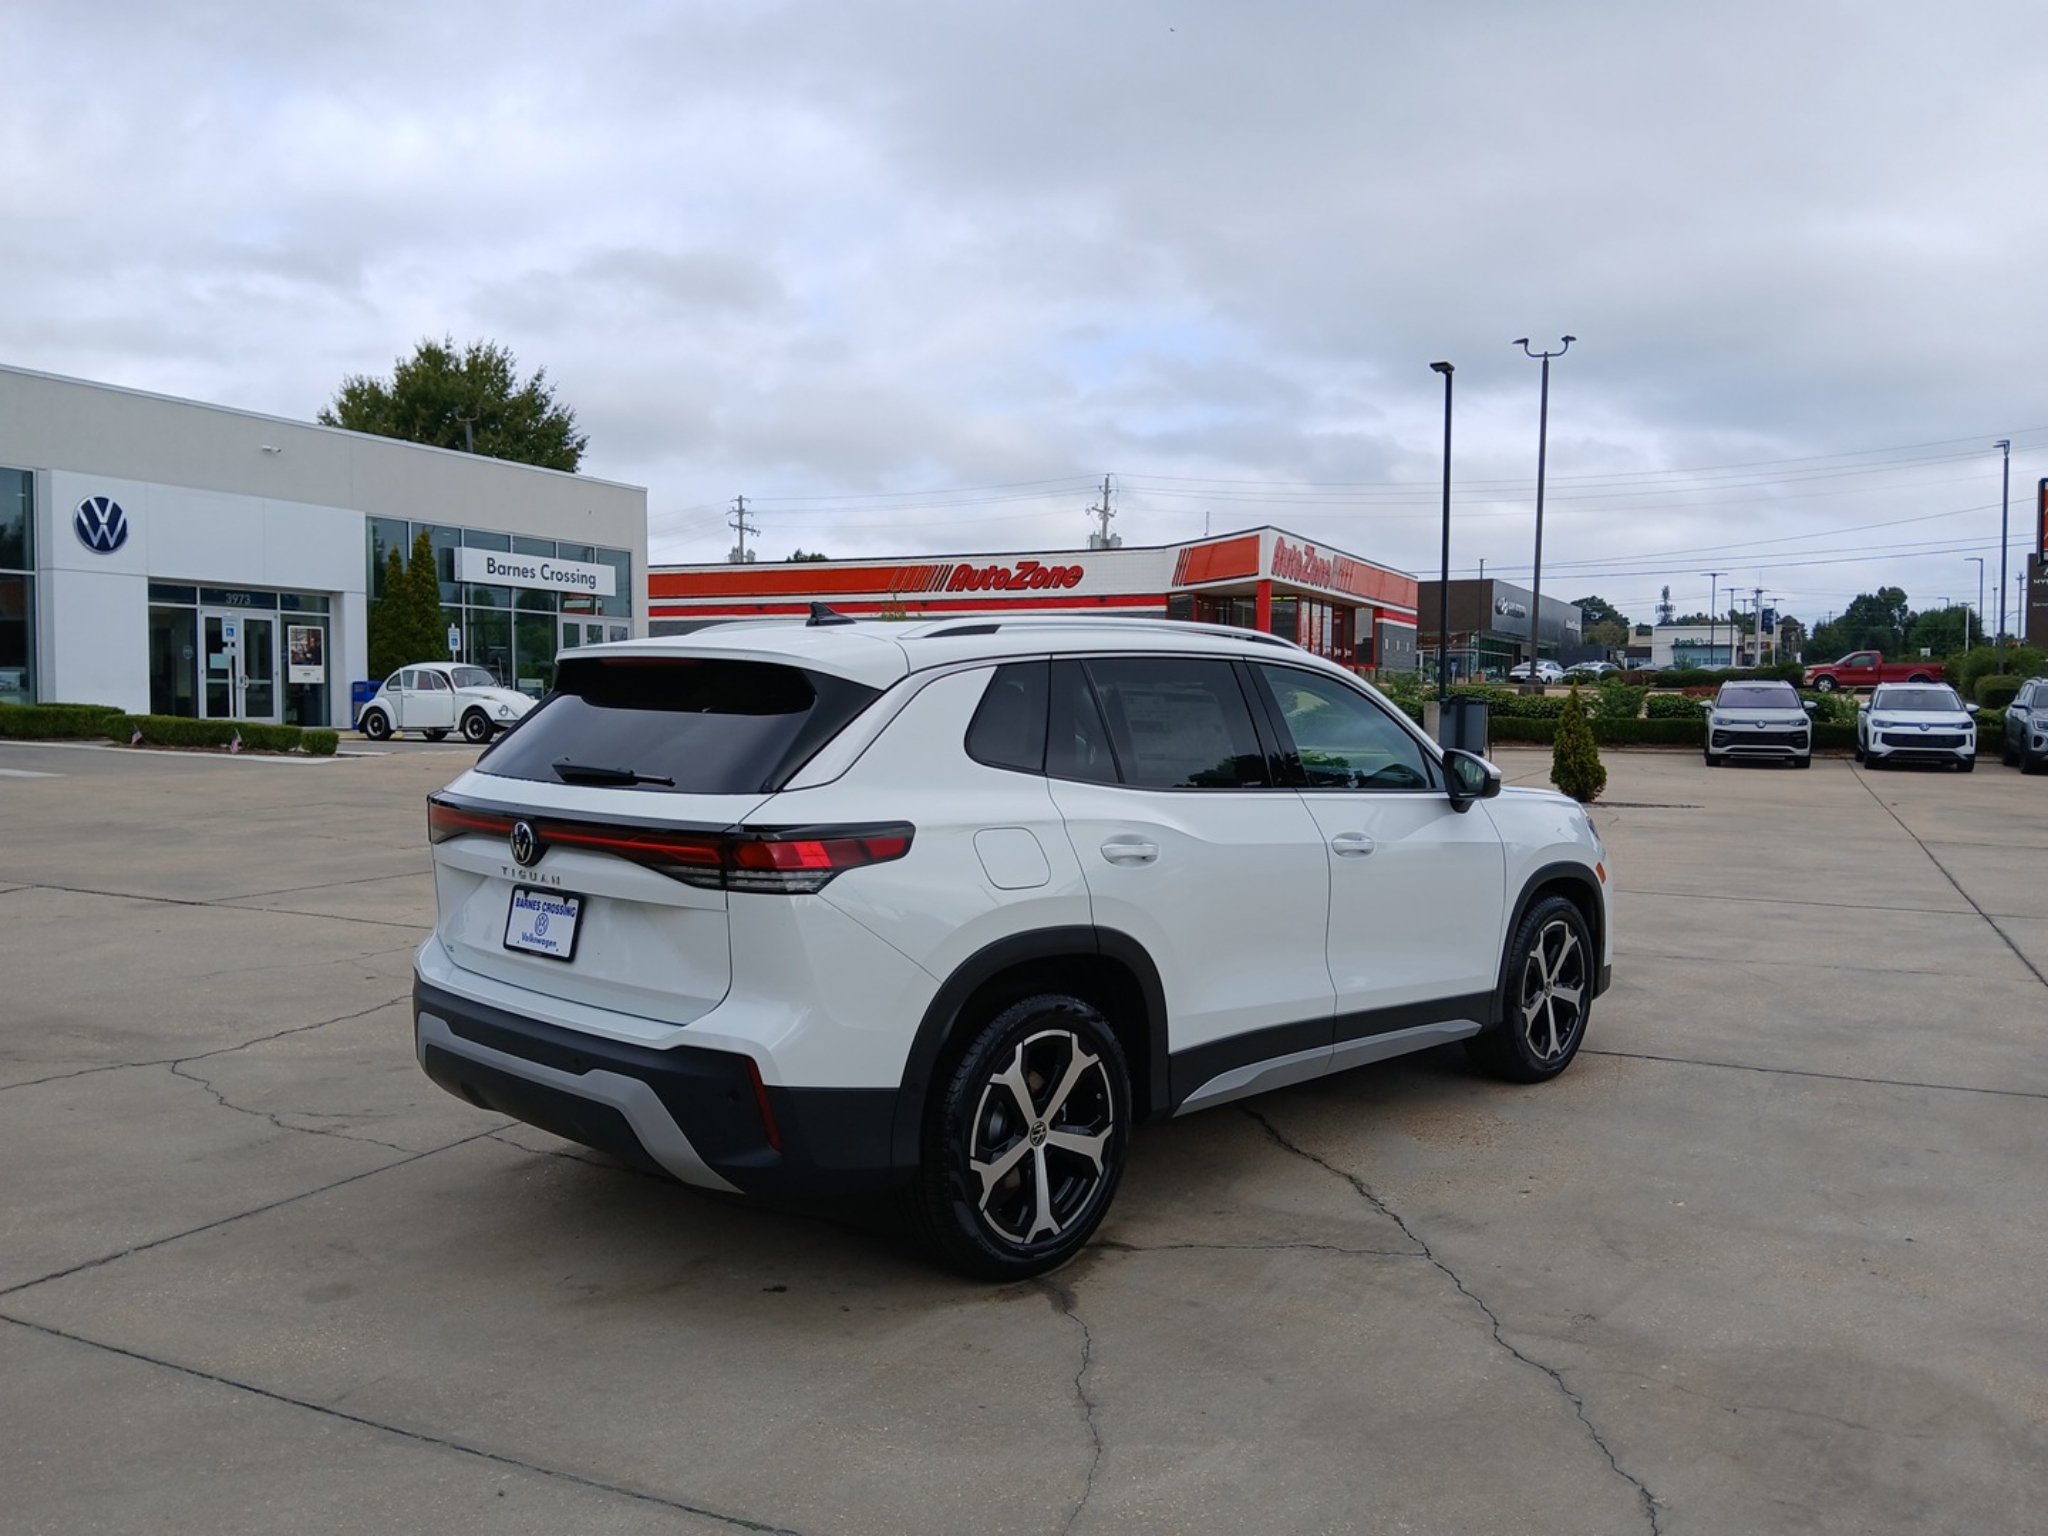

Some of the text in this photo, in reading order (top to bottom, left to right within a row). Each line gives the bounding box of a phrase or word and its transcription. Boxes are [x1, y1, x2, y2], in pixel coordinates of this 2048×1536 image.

[486, 556, 597, 590] Barnes Crossing
[1271, 535, 1332, 590] AutoZone
[945, 561, 1084, 592] AutoZone
[225, 592, 252, 605] 3973
[501, 865, 561, 886] TIGUAN
[515, 897, 577, 918] BARNES CROSSING
